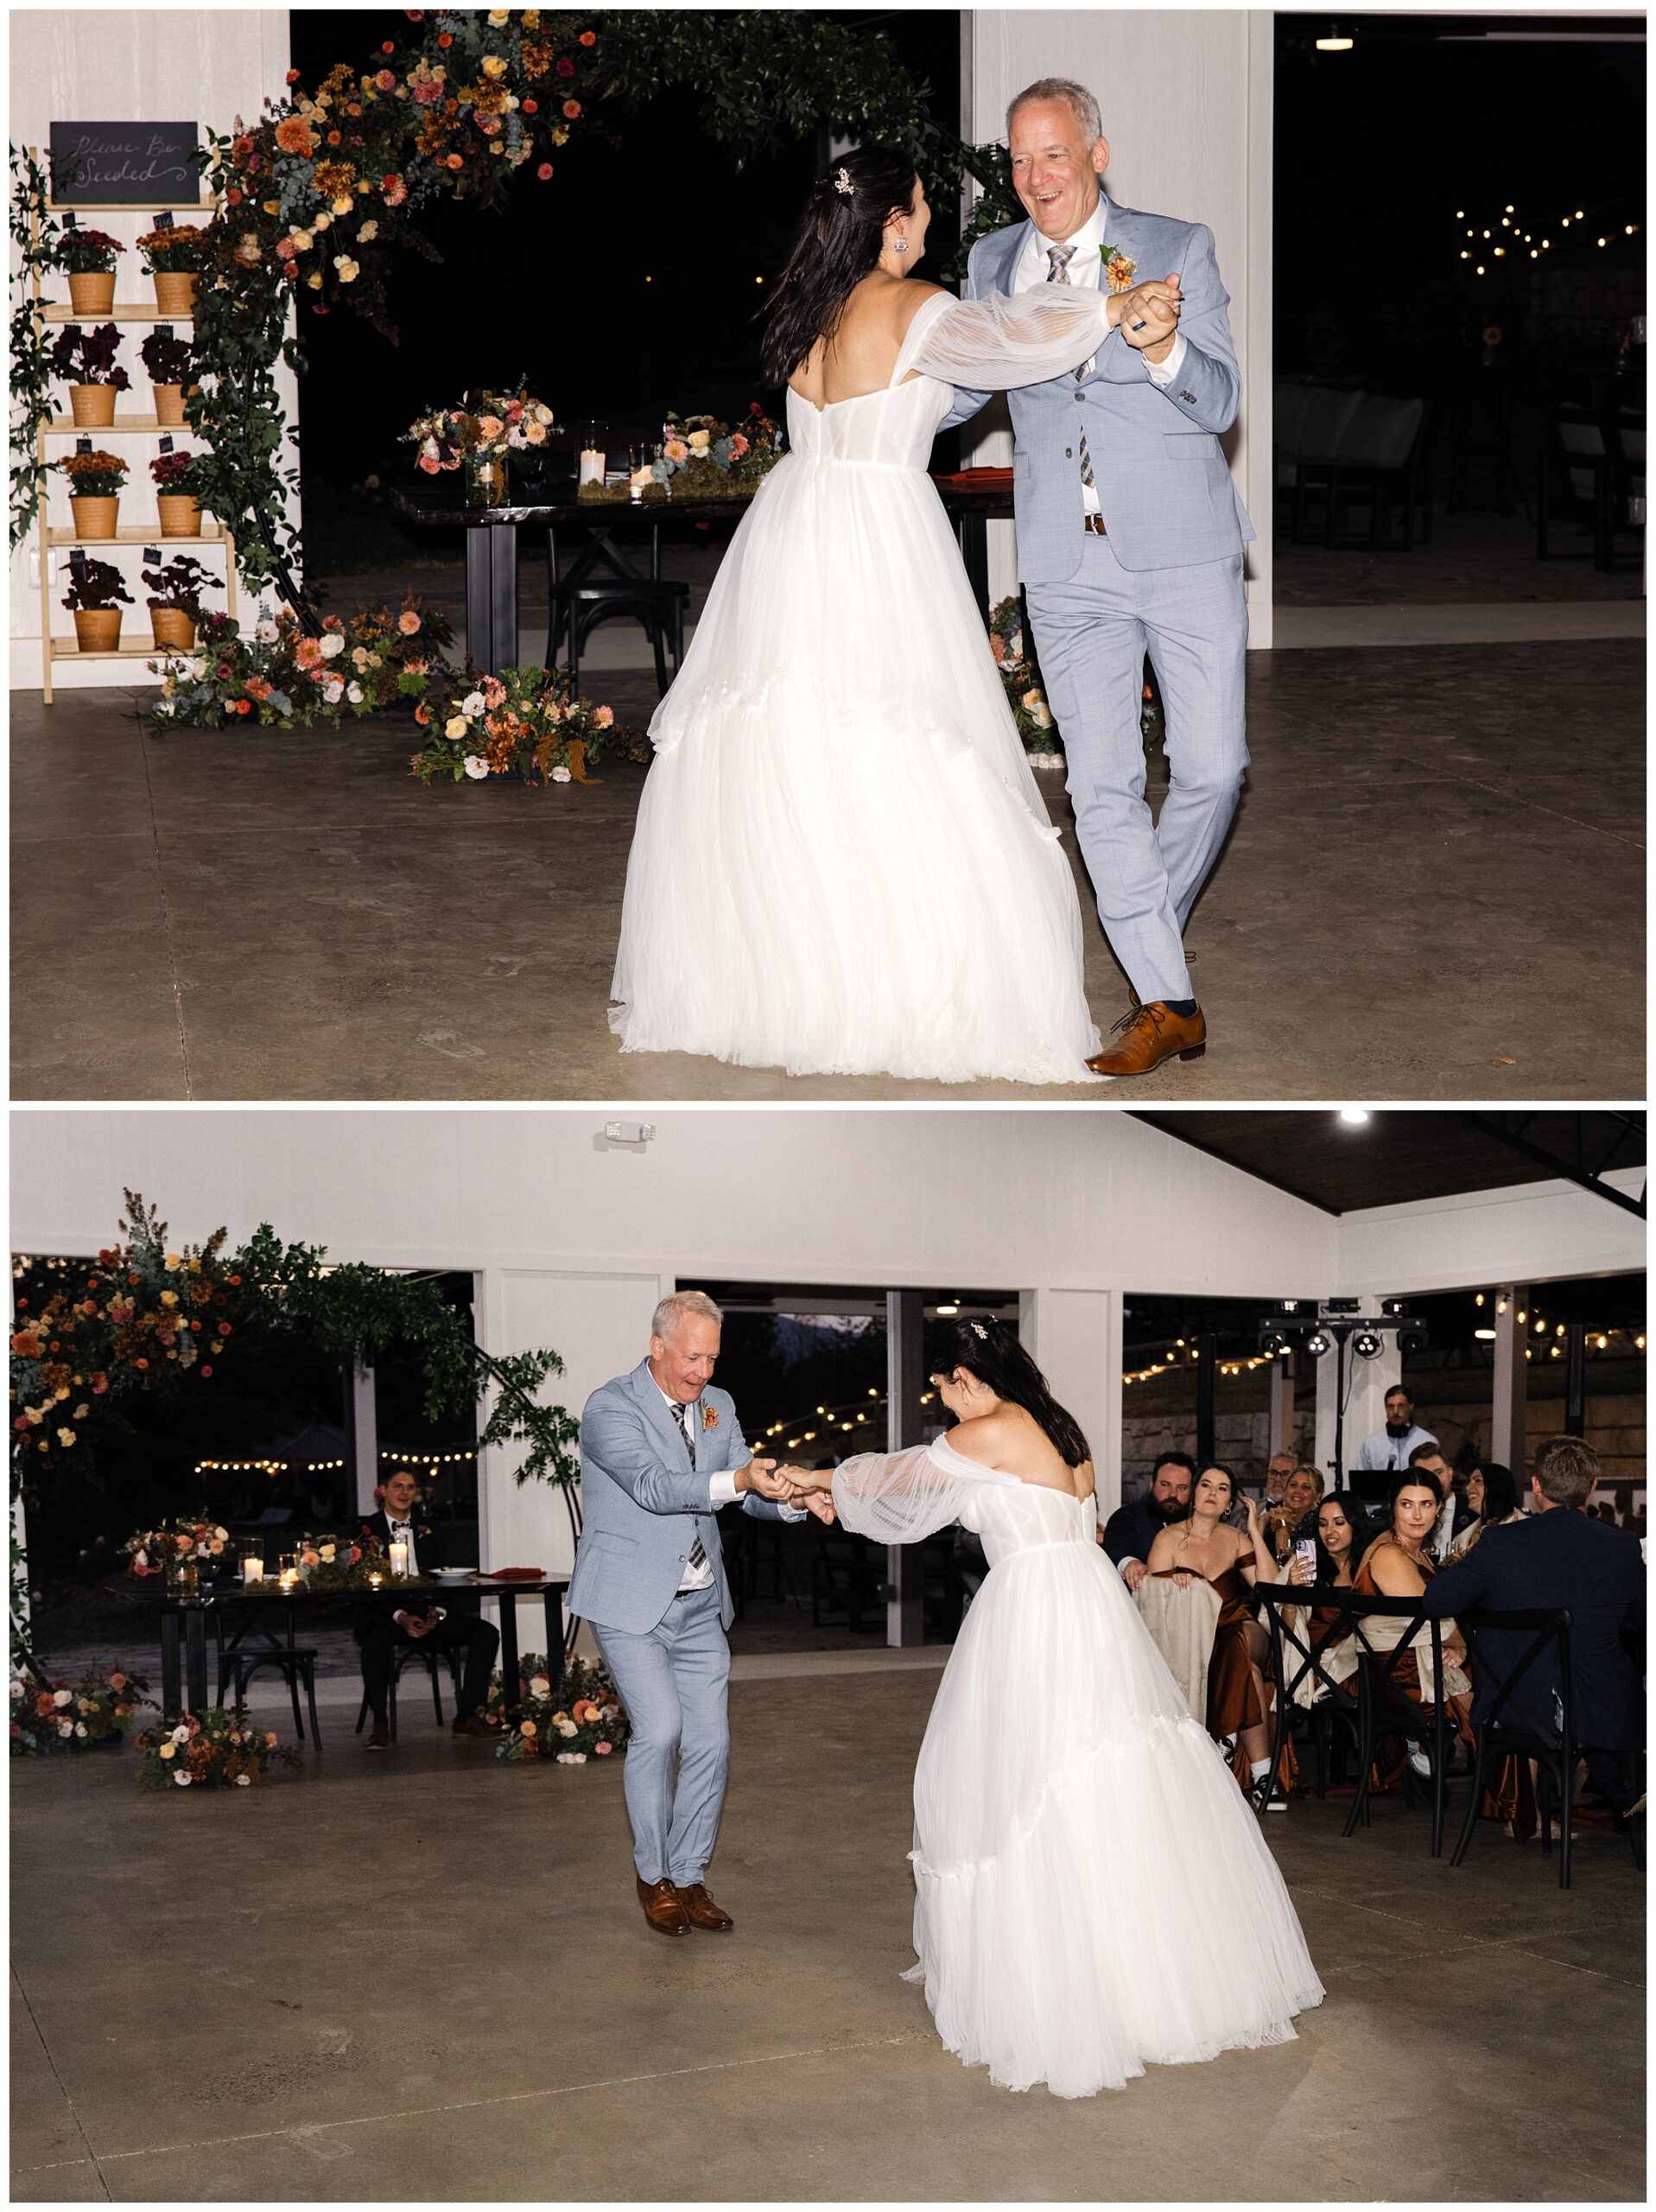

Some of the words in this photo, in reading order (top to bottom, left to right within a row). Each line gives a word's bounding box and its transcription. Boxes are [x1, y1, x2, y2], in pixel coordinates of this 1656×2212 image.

[72, 134, 139, 157] Please
[146, 134, 181, 156] Be
[74, 157, 187, 188] Seeded
